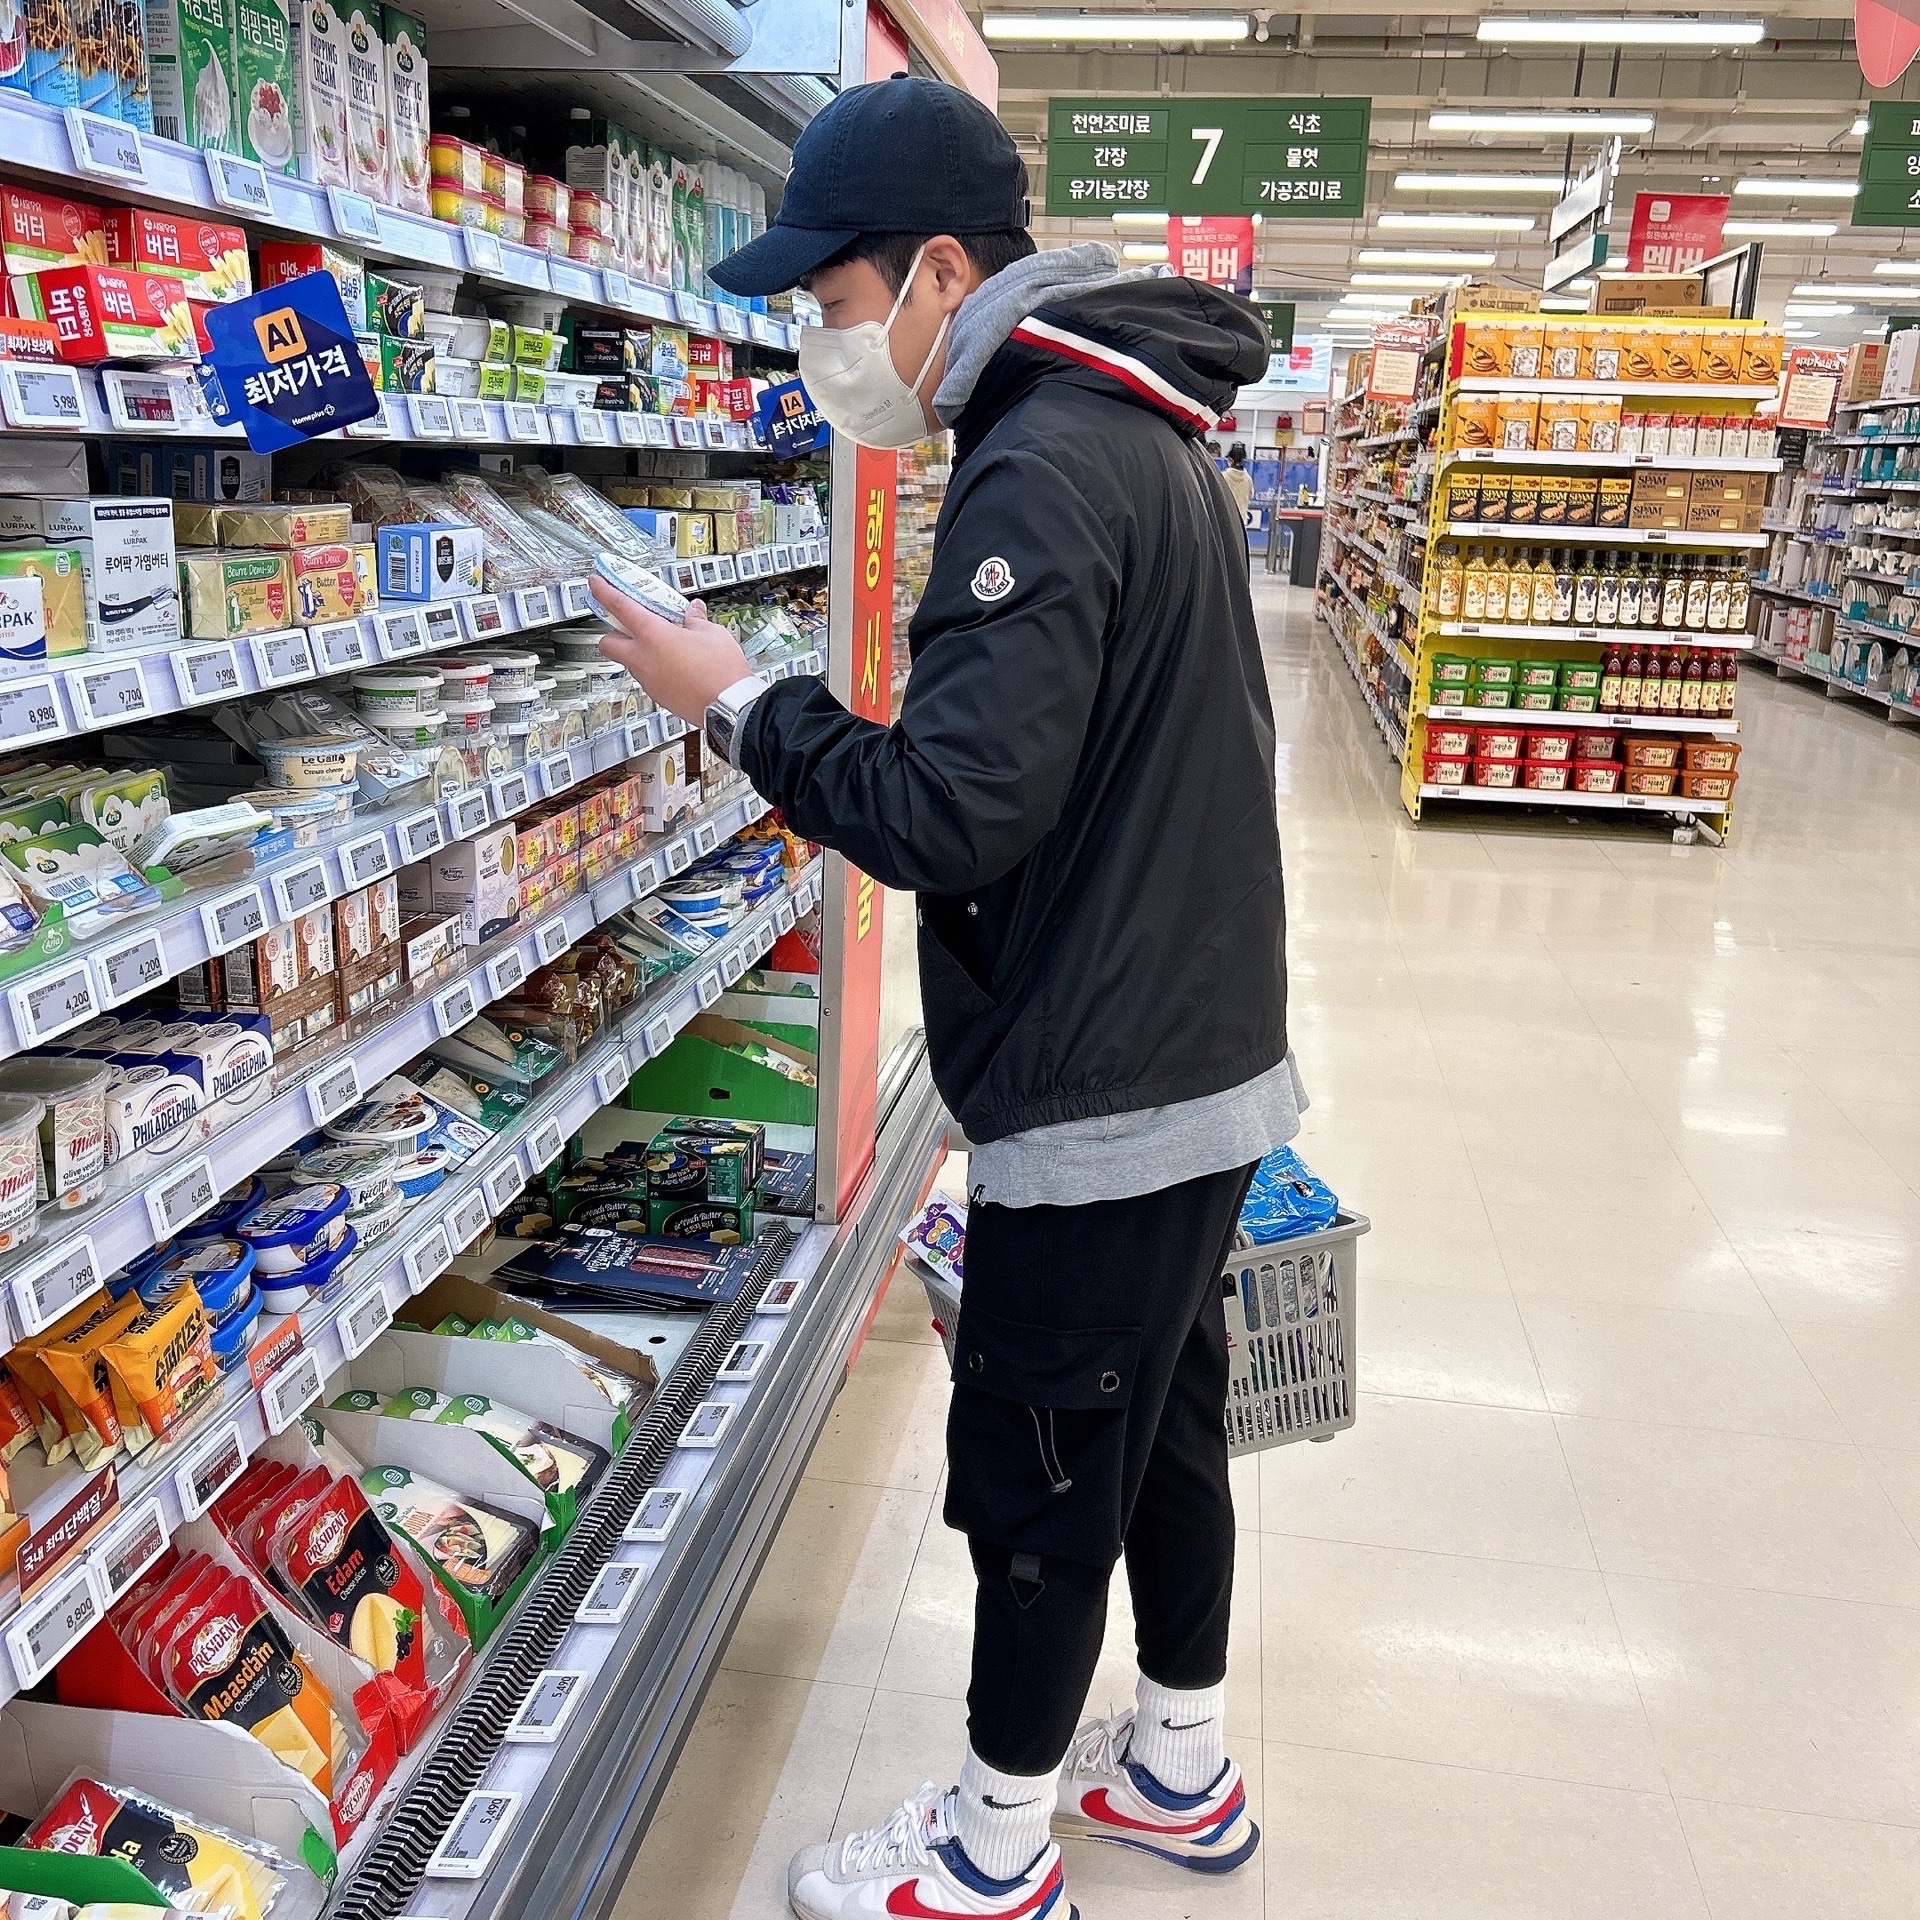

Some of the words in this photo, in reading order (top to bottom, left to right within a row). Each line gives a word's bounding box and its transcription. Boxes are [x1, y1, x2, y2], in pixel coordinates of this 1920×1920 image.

[240, 5, 285, 52] 휘핑크림
[310, 32, 338, 65] WHIPPING
[313, 57, 337, 89] CREAM
[348, 52, 378, 83] WHIPPING
[1071, 113, 1151, 135] 천연조미료
[1288, 114, 1321, 135] 식초
[117, 148, 140, 166] 6,980
[1093, 147, 1127, 168] 간장
[1191, 128, 1224, 185] 7
[1286, 147, 1319, 168] 물엿
[1068, 180, 1150, 200] 유기농간장
[1259, 181, 1342, 202] 가공조미료
[13, 212, 46, 244] 버터
[144, 233, 180, 264] 버터
[1182, 247, 1238, 281] 멤버
[49, 288, 82, 341] 버터
[103, 290, 137, 321] 버터
[266, 318, 299, 353] AI
[243, 344, 352, 405] 최저가격
[53, 395, 78, 409] 5,980
[292, 410, 325, 426] Homeplus
[1638, 476, 1666, 486] SPAM
[1695, 478, 1724, 488] SPAM
[1633, 506, 1662, 516] SPAM
[1691, 508, 1720, 518] SPAM
[1, 522, 36, 531] LURPAK
[49, 523, 85, 533] LURPAK
[123, 537, 148, 545] LURPAK
[105, 556, 133, 574] 루어팍
[135, 553, 169, 571] 가염버터
[316, 577, 337, 587] Butter
[978, 581, 1005, 594] MONCLER
[215, 668, 236, 683] 9,900
[119, 688, 143, 704] 9,700
[29, 707, 55, 724] 8,980
[301, 755, 314, 764] Le
[107, 811, 120, 824] Arla
[40, 860, 57, 873] Arla
[243, 911, 261, 926] 4,200
[44, 938, 62, 951] Arla
[139, 957, 160, 976] 4,200
[65, 990, 89, 1011] 4,200
[228, 1051, 251, 1069] ORIGINAL
[213, 1052, 267, 1097] PHILADELPHIA
[151, 1096, 178, 1116] ORIGINAL
[133, 1095, 197, 1149] PHILADELPHIA
[63, 1168, 81, 1179] olive
[82, 1160, 96, 1173] verdi
[191, 1182, 211, 1204] 6,490
[68, 1265, 93, 1291] 7,990
[301, 1372, 318, 1395] 6,780
[224, 1455, 242, 1479] 6,680
[660, 1492, 675, 1511] 5,900
[23, 1549, 45, 1573] 국내
[46, 1529, 65, 1553] 최대
[65, 1487, 103, 1541] 단백질
[142, 1534, 162, 1561] 8,780
[325, 1548, 365, 1596] Edam
[615, 1568, 633, 1587] 5,900
[340, 1579, 356, 1602] Cheese
[354, 1565, 368, 1583] slices
[66, 1597, 93, 1629] 8,800
[188, 1612, 243, 1677] PRÉSIDENT
[202, 1640, 275, 1720] Maasdam
[551, 1676, 572, 1698] 5,490
[233, 1687, 254, 1713] Cheese
[251, 1674, 267, 1696] slices
[480, 1798, 503, 1824] 5,490
